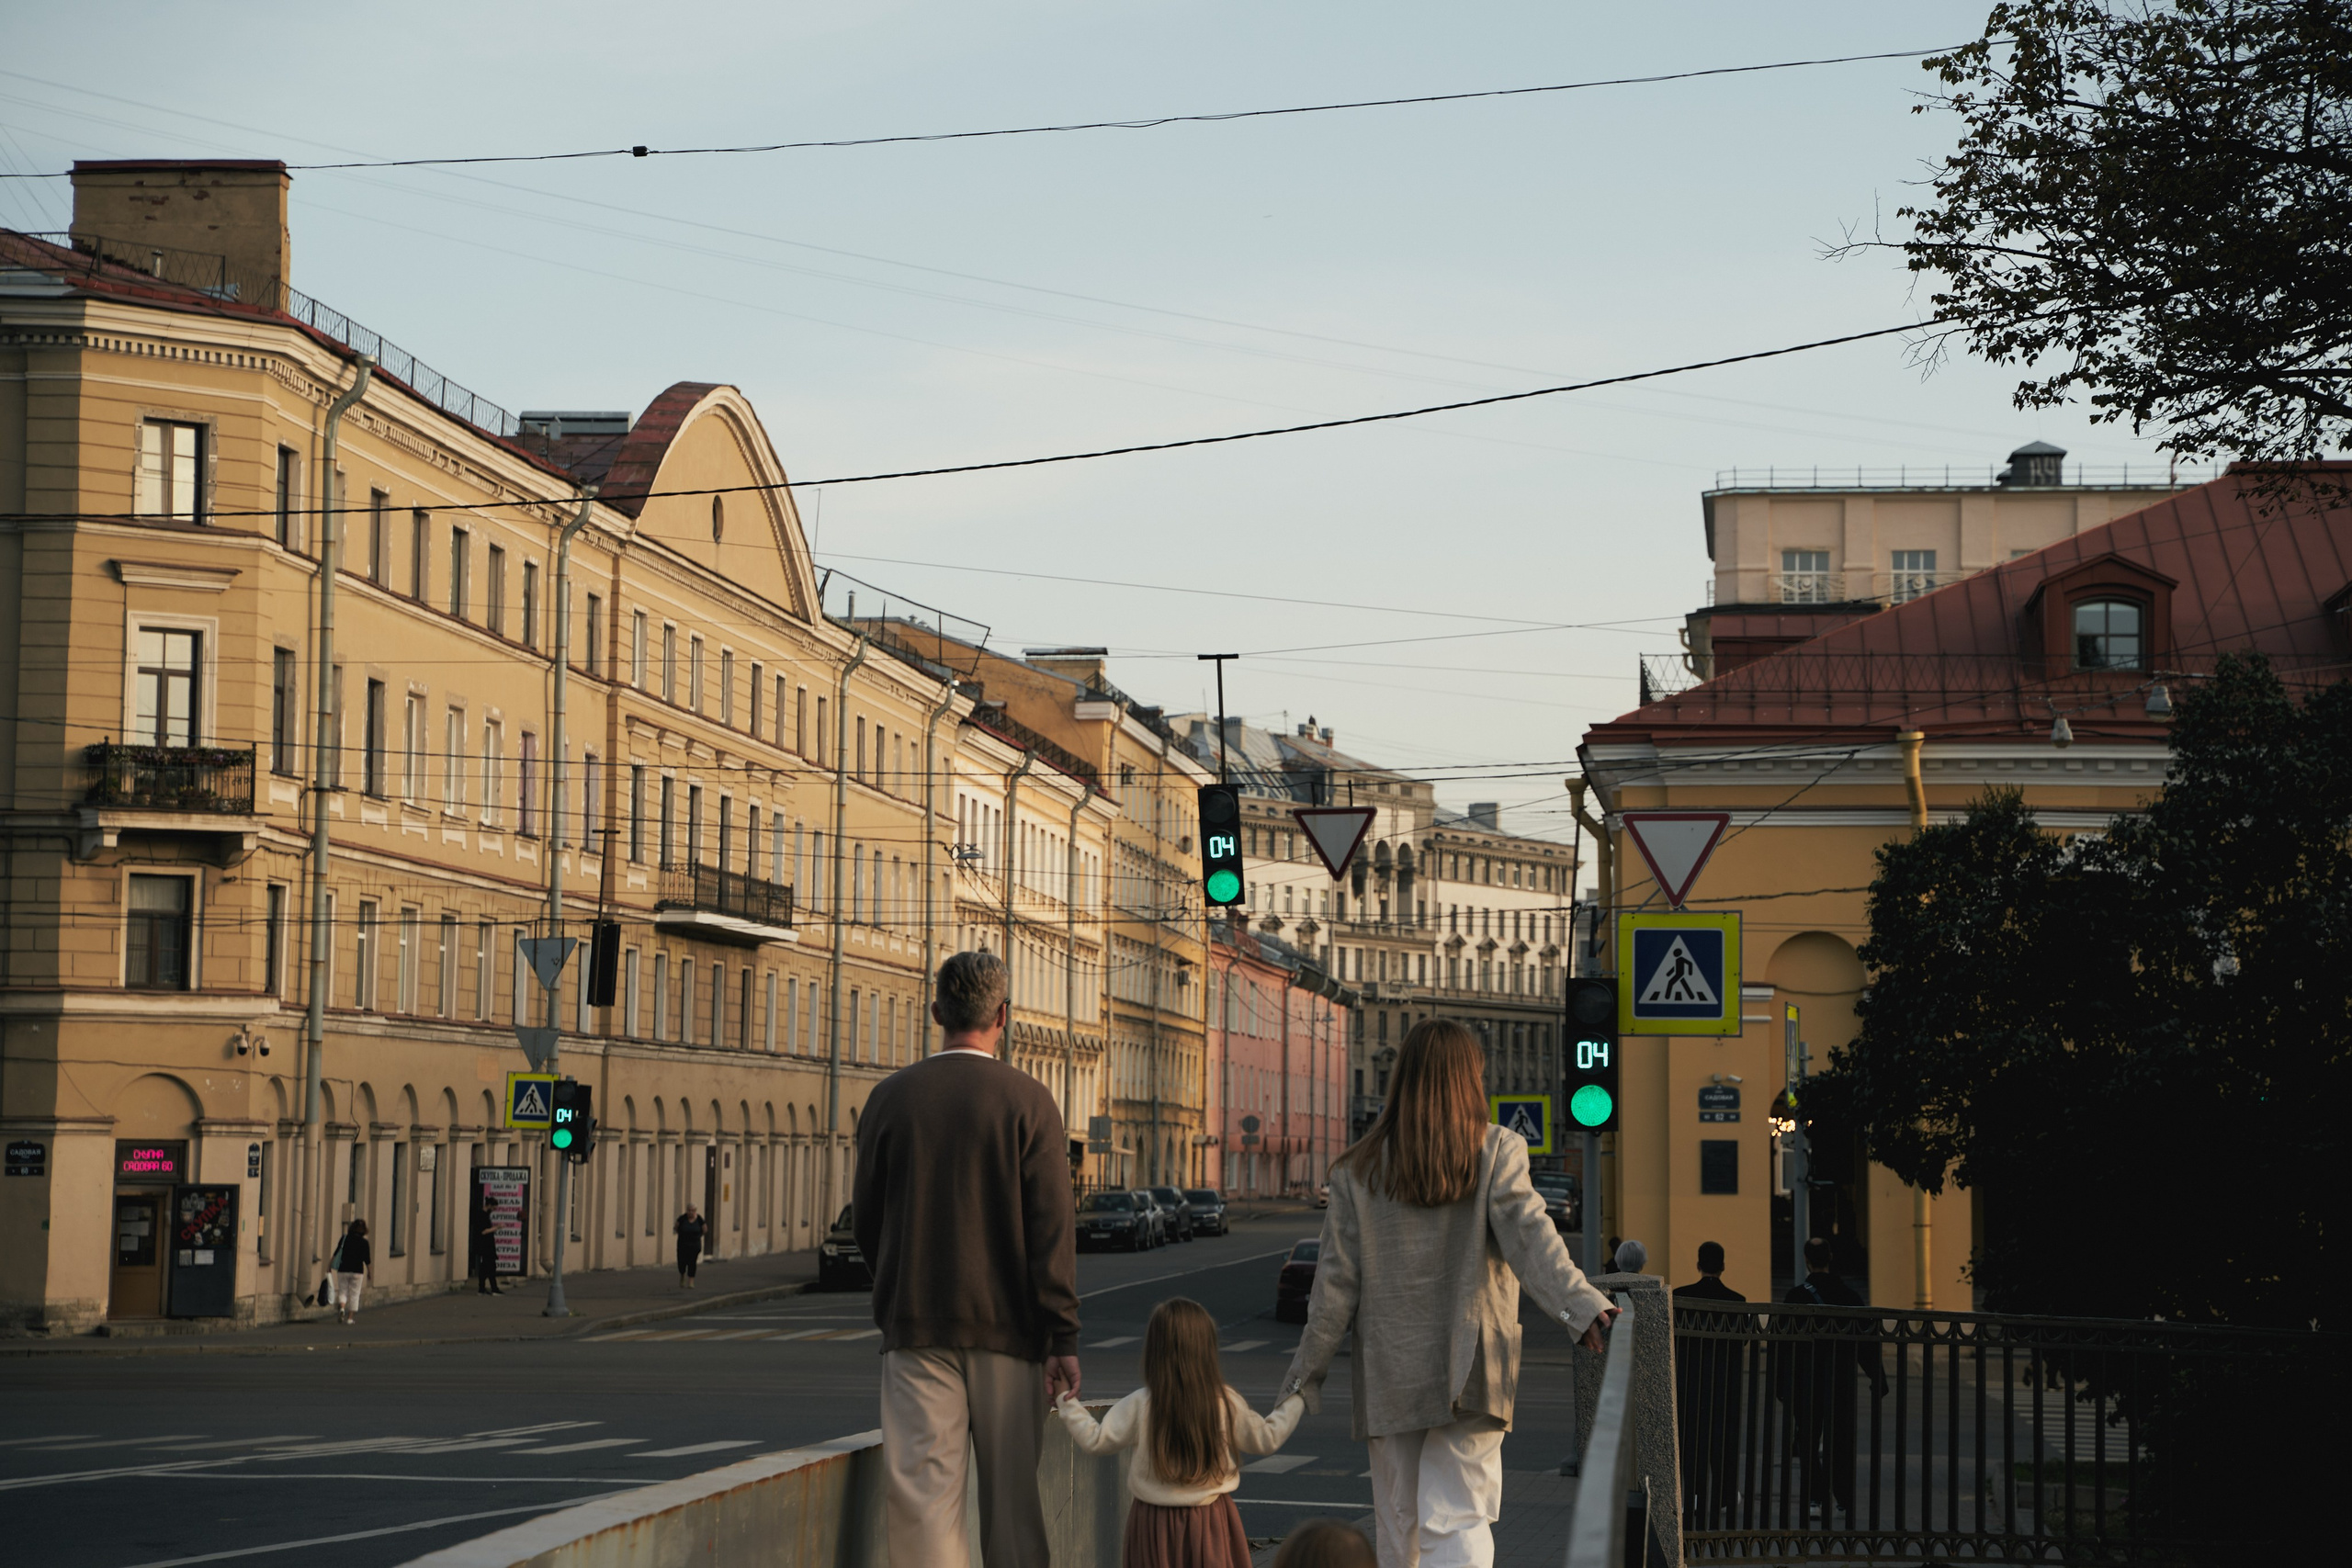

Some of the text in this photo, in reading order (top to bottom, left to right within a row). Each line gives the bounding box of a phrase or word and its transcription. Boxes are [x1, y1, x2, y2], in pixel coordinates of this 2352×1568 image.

[1209, 836, 1235, 859] 04
[1577, 1041, 1609, 1069] 04
[556, 1108, 572, 1123] 04
[9, 1148, 41, 1156] САДОВАЯ
[123, 1160, 173, 1172] САДОВАЯ 60
[481, 1171, 500, 1181] СКУПКА
[503, 1171, 527, 1182] ПРОДАЖА
[180, 1196, 229, 1241] СКУПКА
